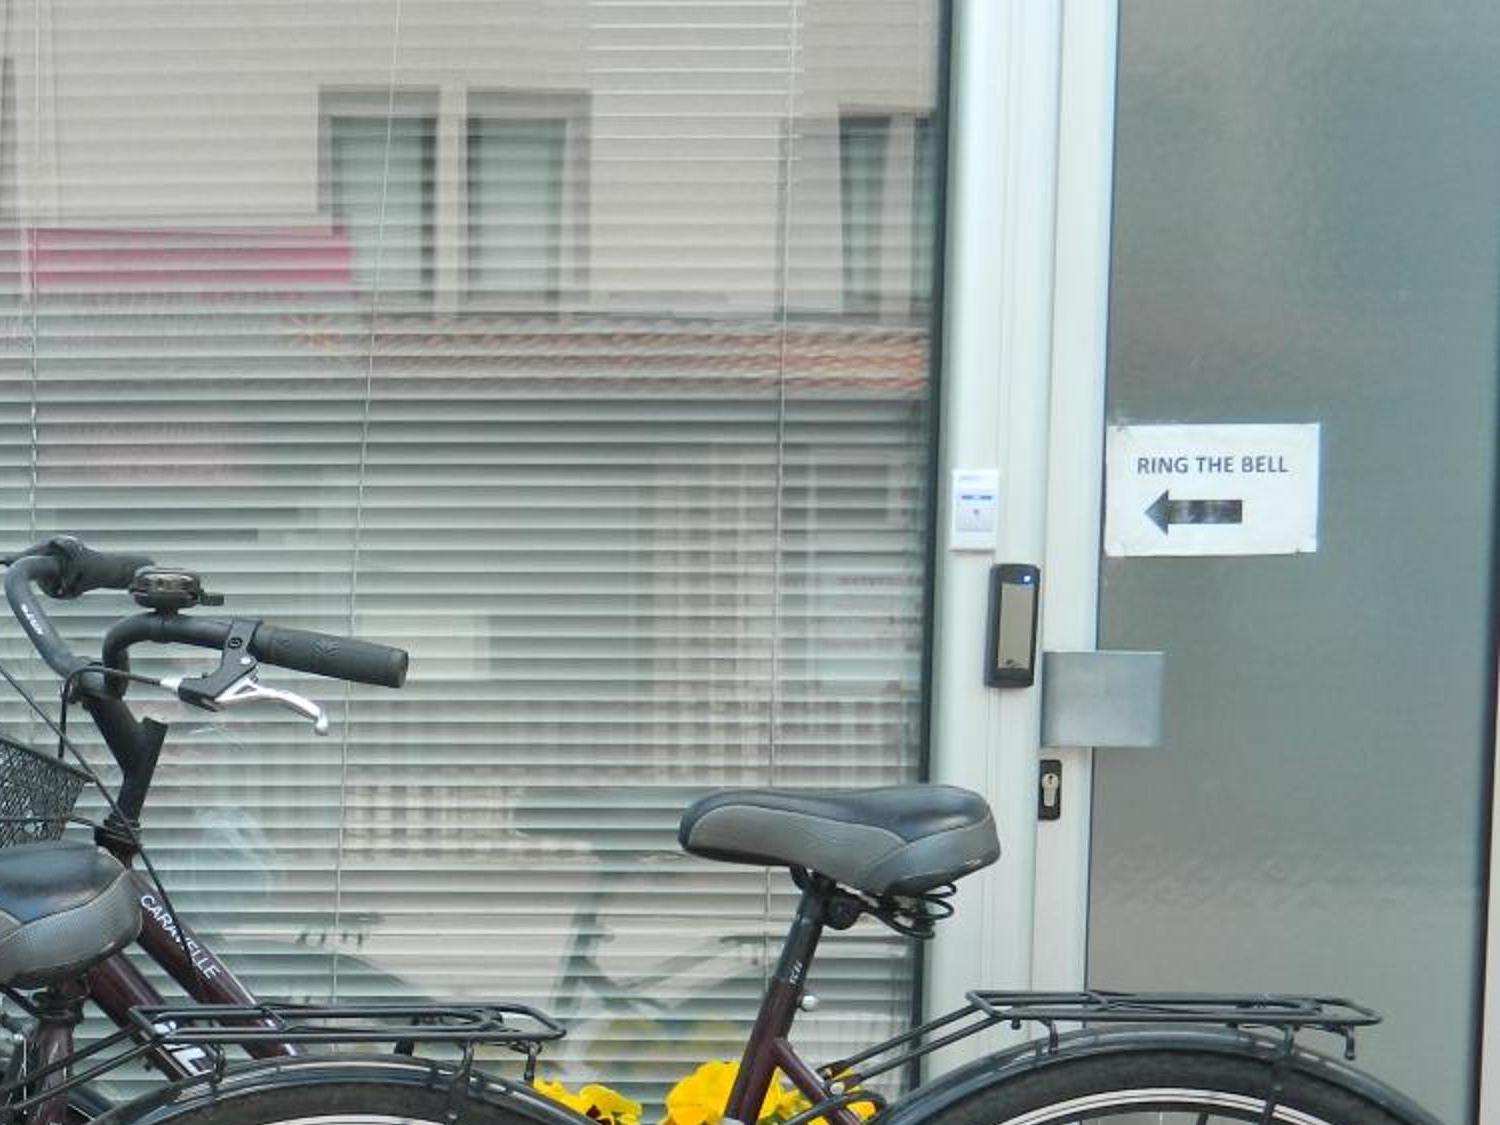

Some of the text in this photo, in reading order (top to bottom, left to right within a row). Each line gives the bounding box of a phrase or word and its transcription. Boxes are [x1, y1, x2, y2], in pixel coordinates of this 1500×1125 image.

[1137, 455, 1289, 474] RING THE BELL
